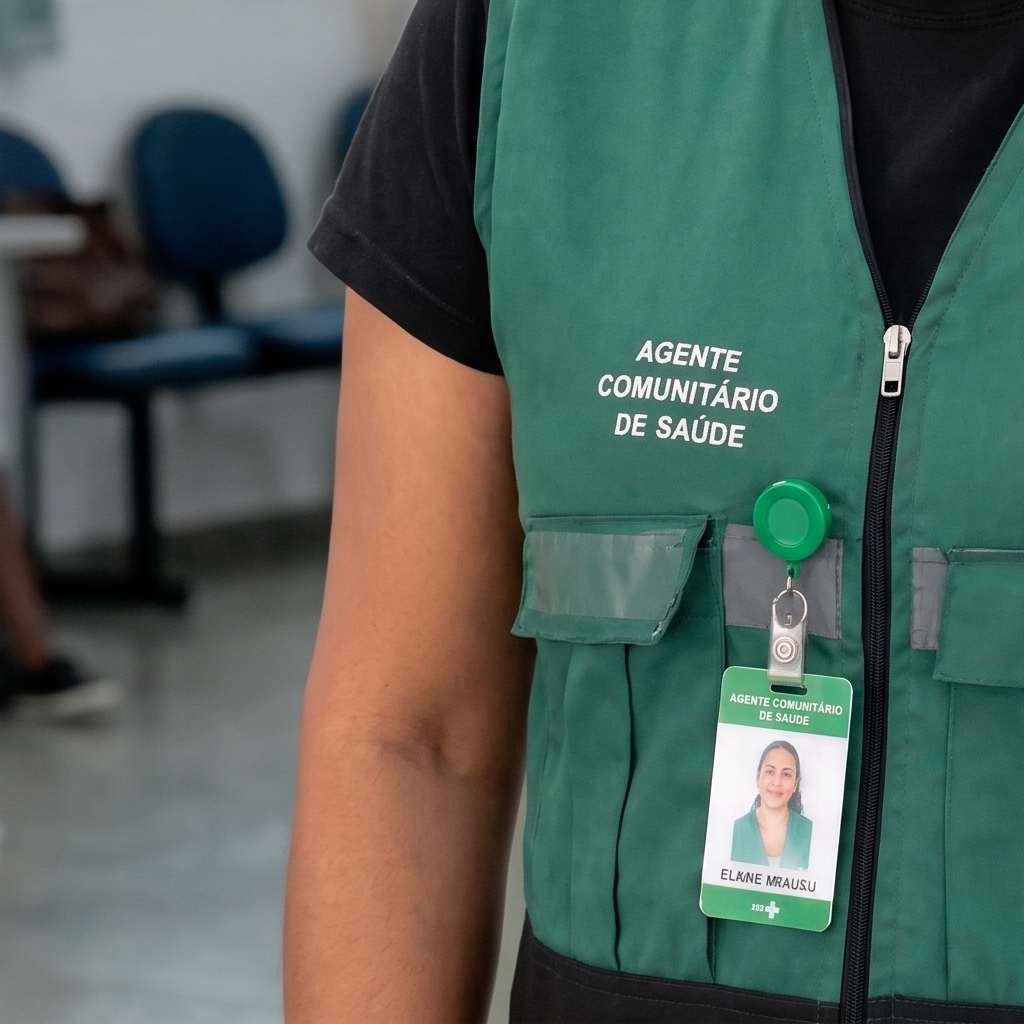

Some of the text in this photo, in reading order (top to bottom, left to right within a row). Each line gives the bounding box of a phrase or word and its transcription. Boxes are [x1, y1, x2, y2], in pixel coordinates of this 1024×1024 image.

[635, 340, 743, 373] AGENTE
[598, 374, 779, 413] COMUNITÁRIO
[614, 413, 746, 448] DE SAÚDE
[729, 693, 843, 715] AGENTE COMUNITÁRIO
[759, 710, 773, 721] DE
